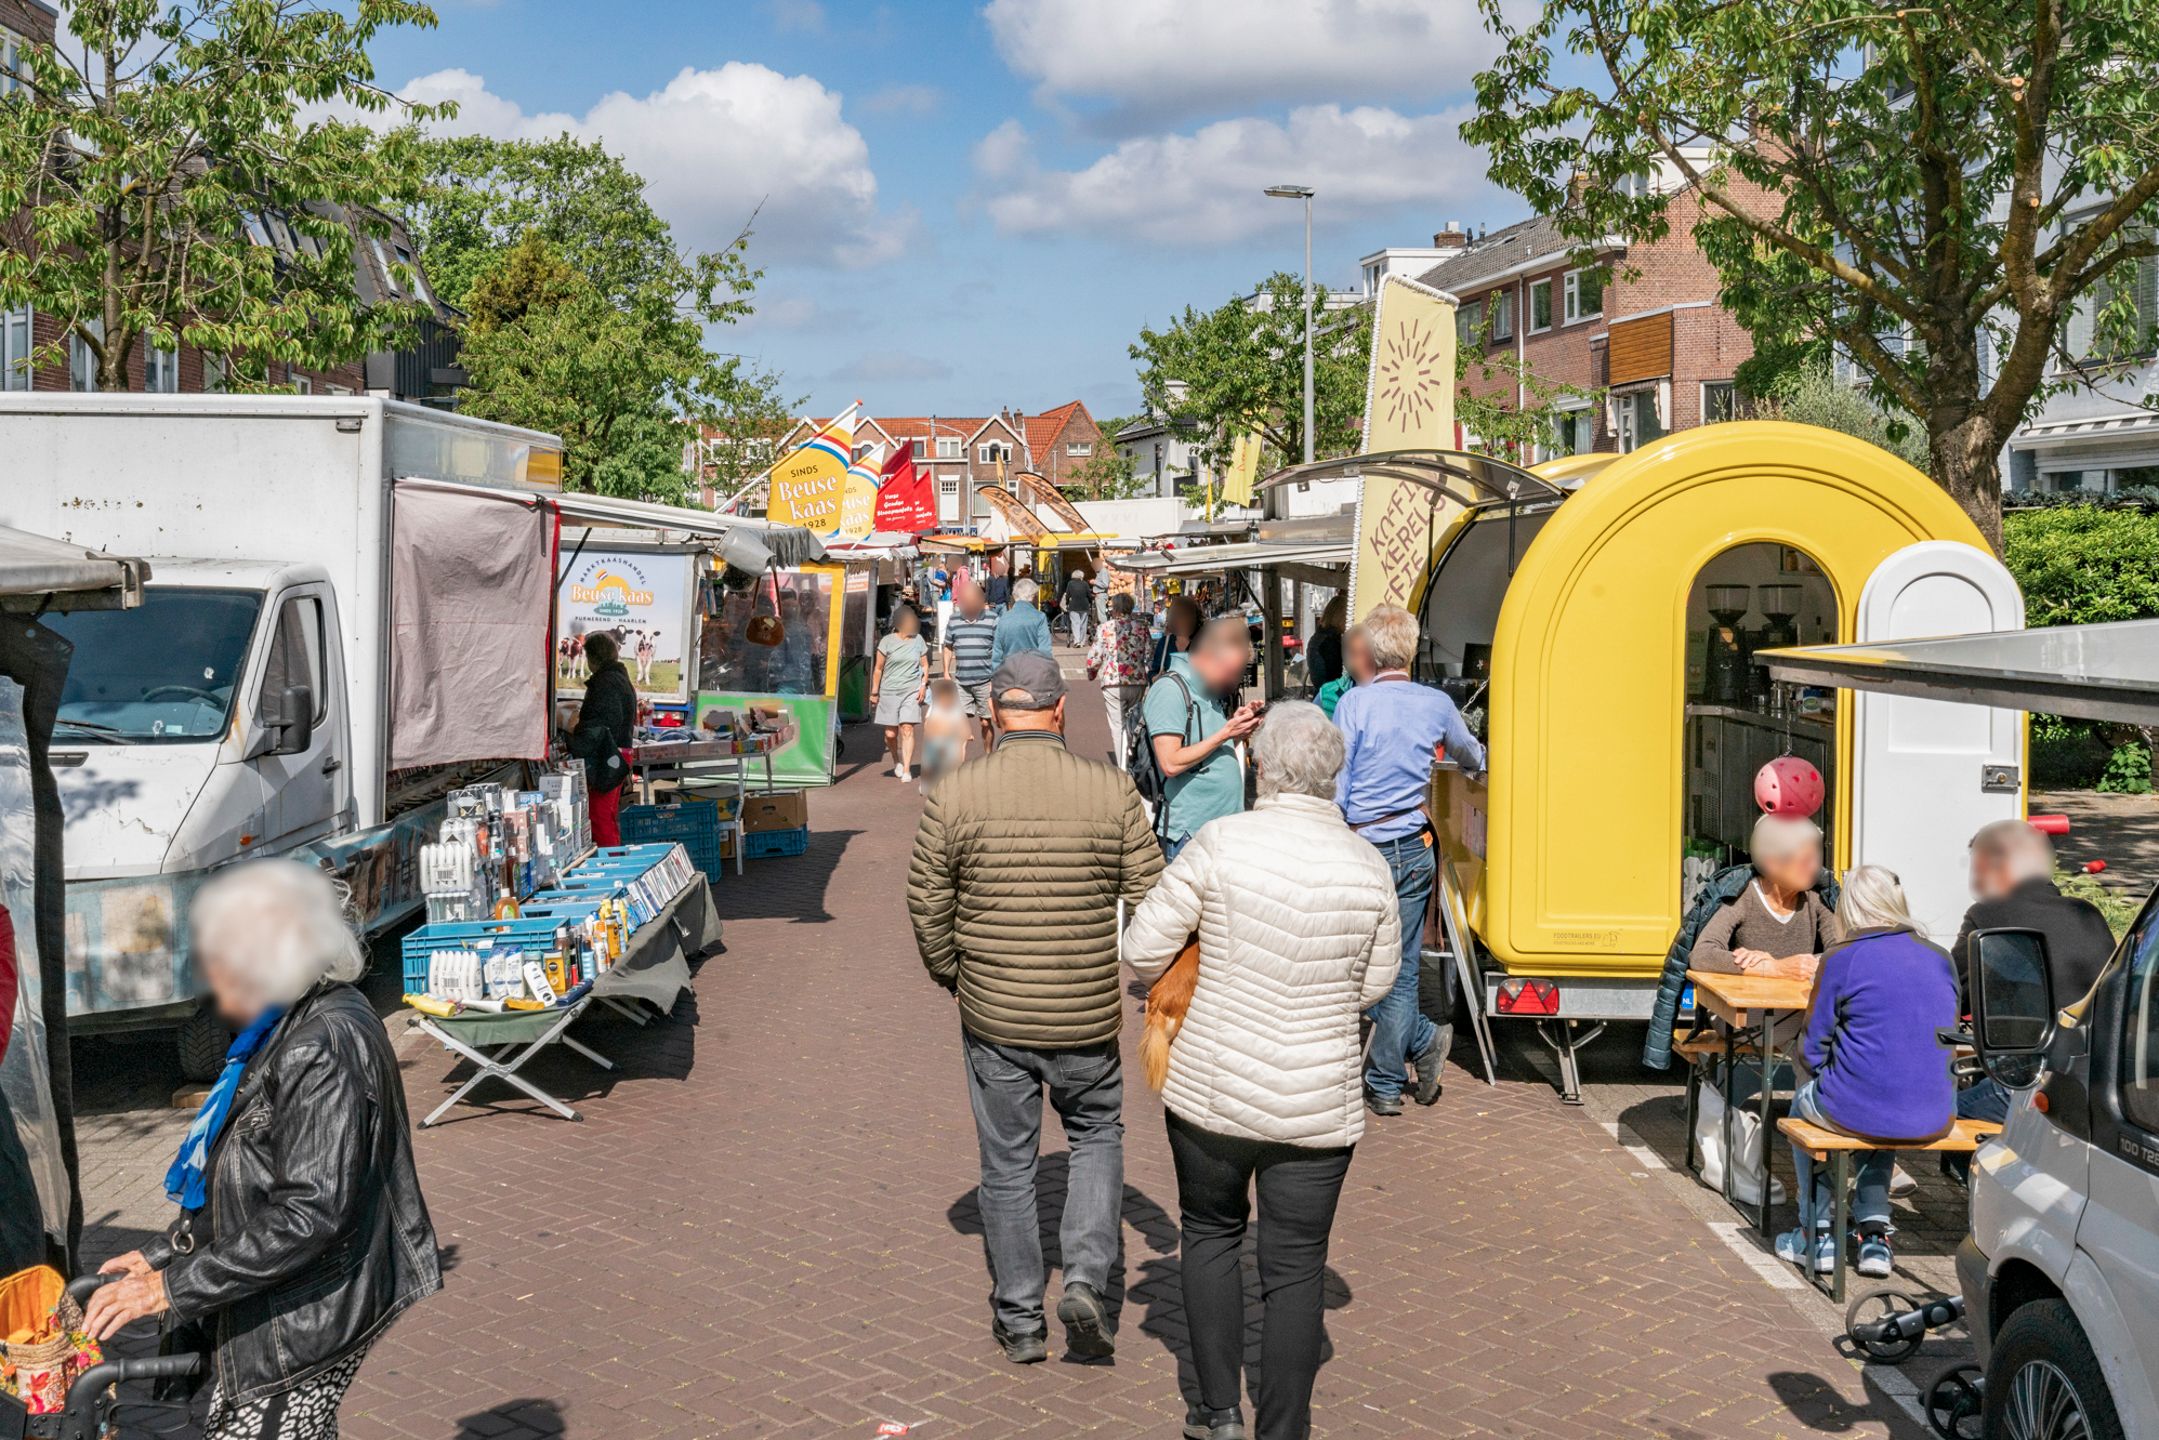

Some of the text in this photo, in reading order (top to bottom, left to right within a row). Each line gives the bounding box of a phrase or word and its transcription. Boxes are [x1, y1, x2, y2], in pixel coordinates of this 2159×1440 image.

[790, 465, 818, 478] SINDS
[778, 475, 837, 501] Beuse
[789, 498, 836, 520] kaas
[1370, 480, 1422, 556] KOFFI
[803, 518, 826, 529] 1928
[1381, 489, 1446, 580] KERELS
[580, 557, 647, 585] MARKTKAASHANDEL
[573, 585, 653, 604] Beuse kaas
[2120, 1137, 2139, 1156] 100
